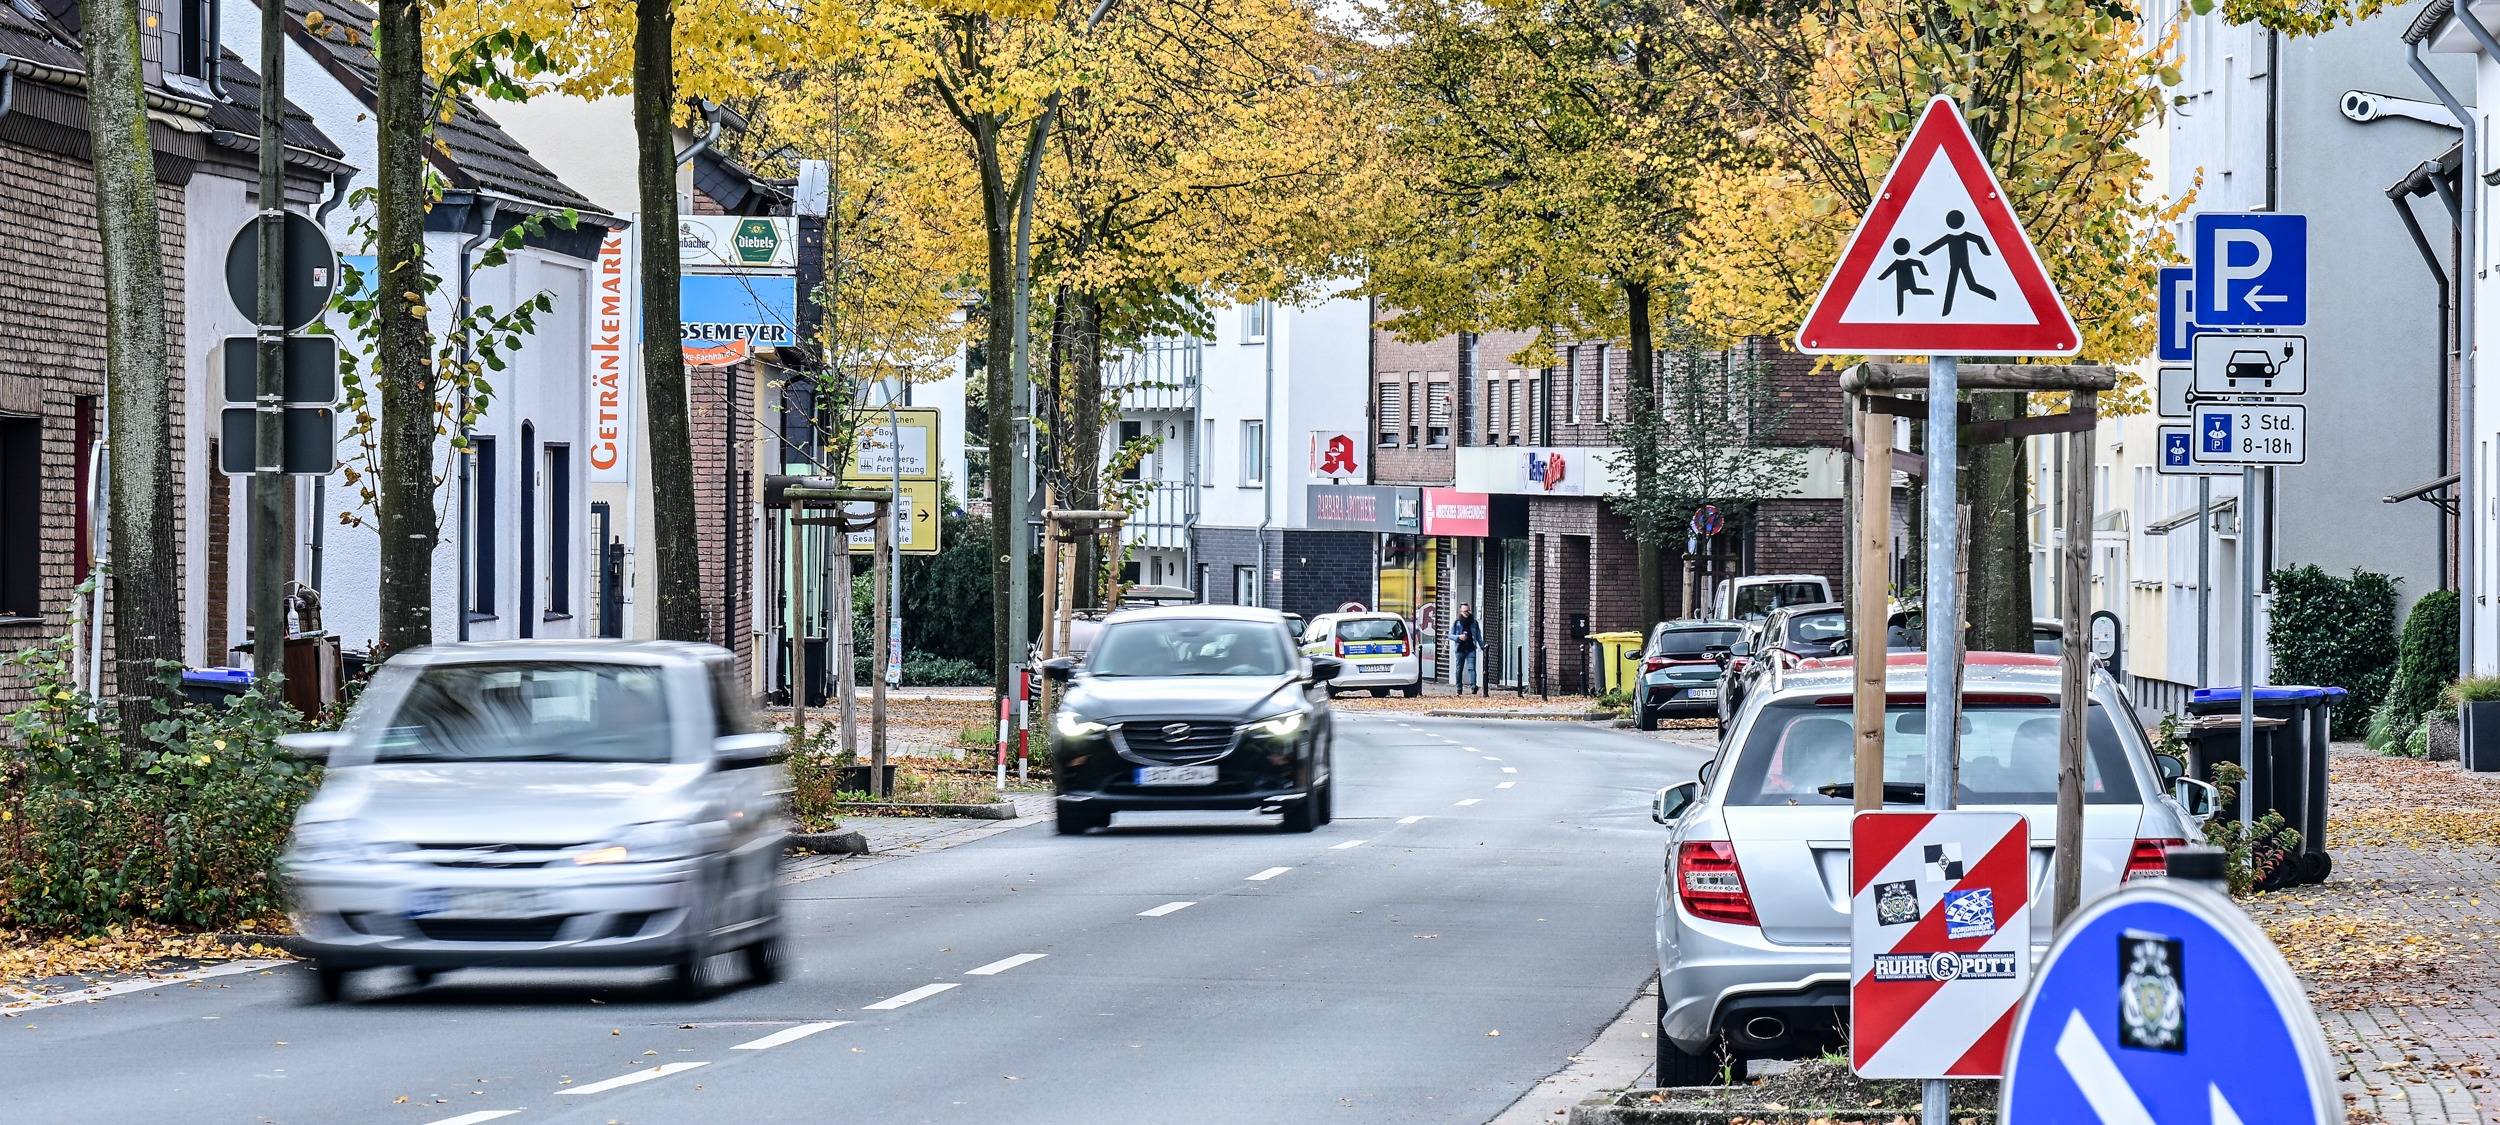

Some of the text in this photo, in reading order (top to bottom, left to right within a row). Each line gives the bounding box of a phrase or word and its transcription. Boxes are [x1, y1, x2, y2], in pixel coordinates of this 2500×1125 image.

[2214, 229, 2273, 312] P
[590, 225, 623, 470] GETRÄNKEMARK
[2241, 414, 2295, 430] 3 Std.
[1875, 960, 1929, 975] RUHR
[1961, 958, 2015, 973] POTT
